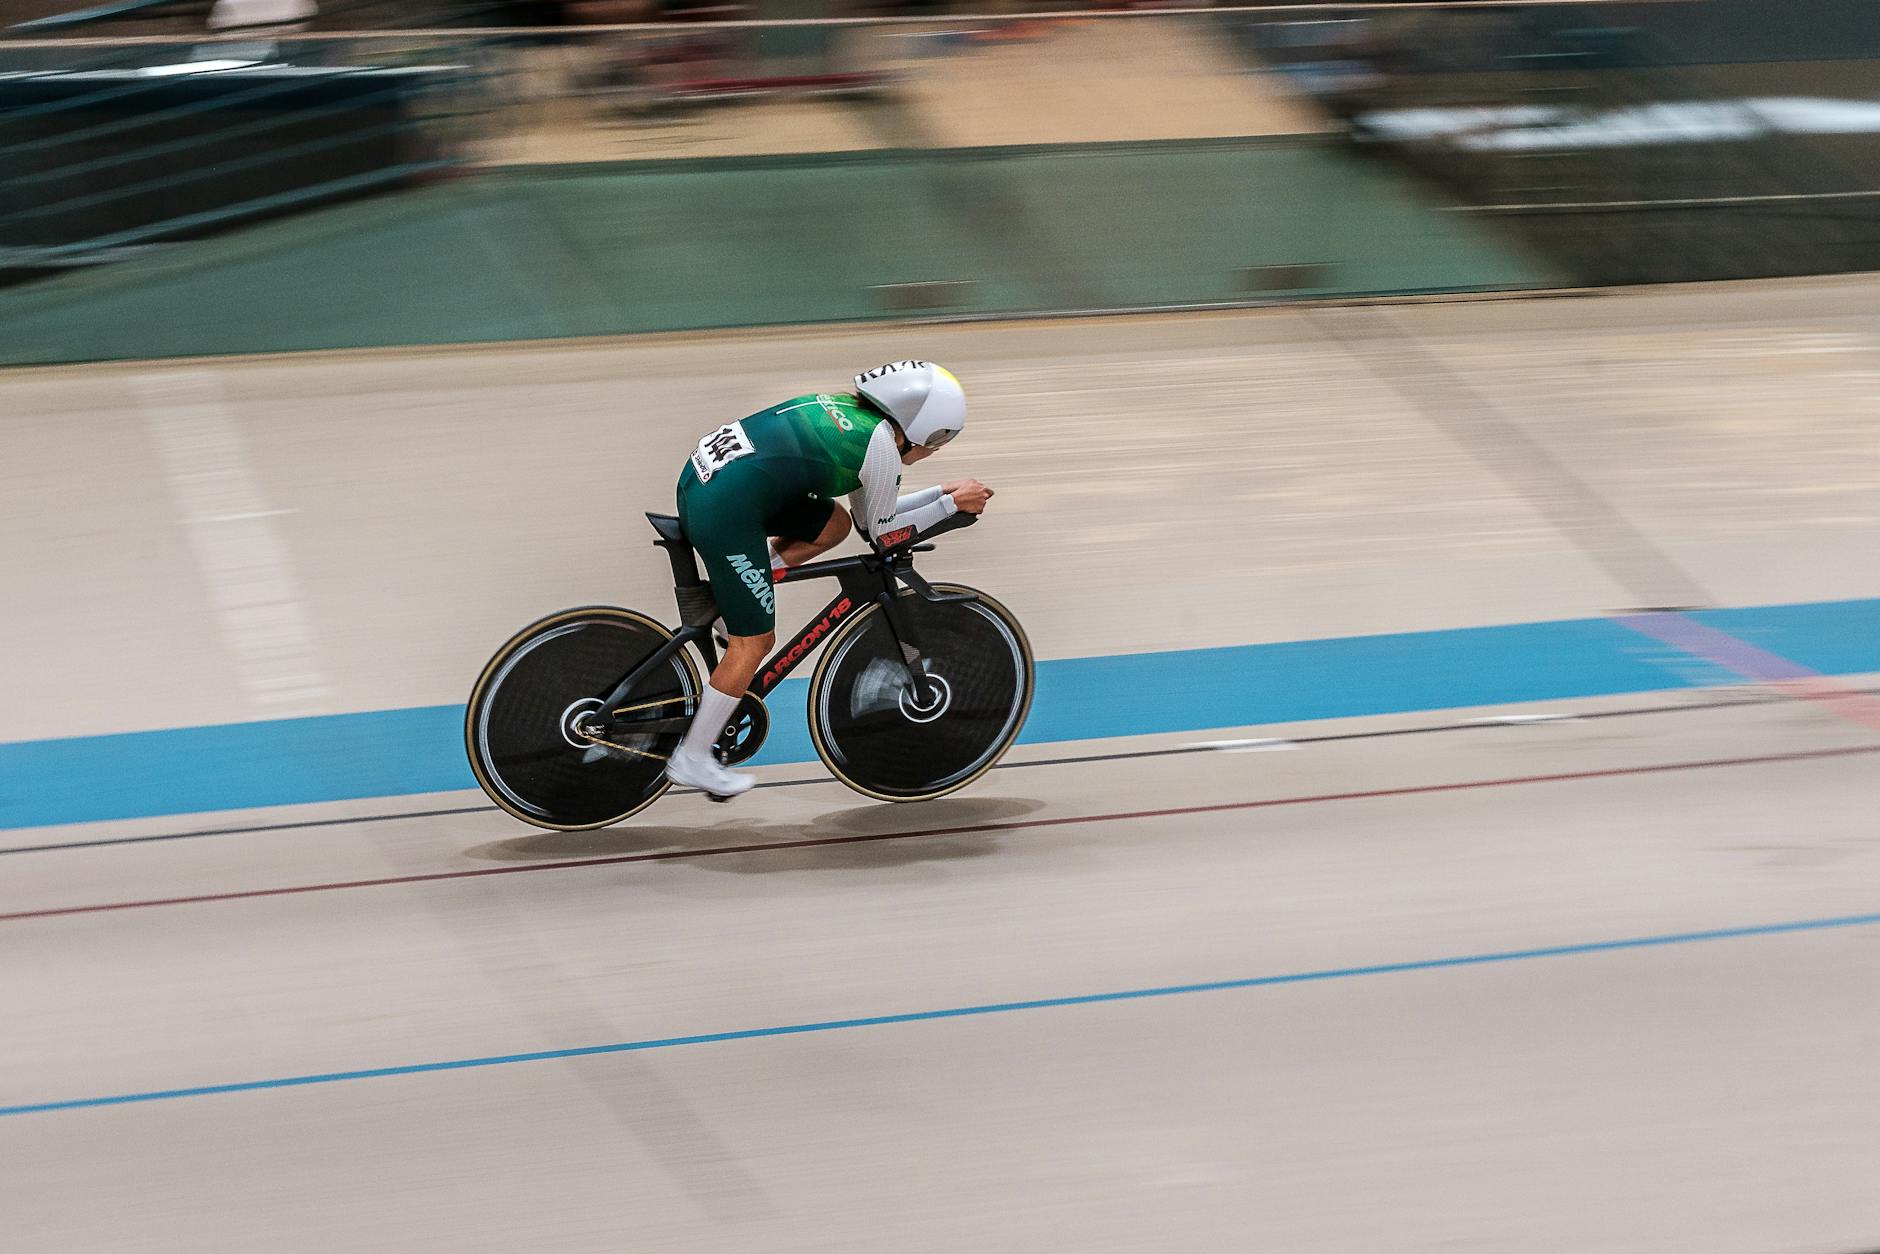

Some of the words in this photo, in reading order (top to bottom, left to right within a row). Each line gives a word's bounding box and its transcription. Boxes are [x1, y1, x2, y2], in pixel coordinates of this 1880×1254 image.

[704, 428, 742, 463] 144
[763, 617, 831, 688] ARGON
[829, 597, 852, 619] 18
